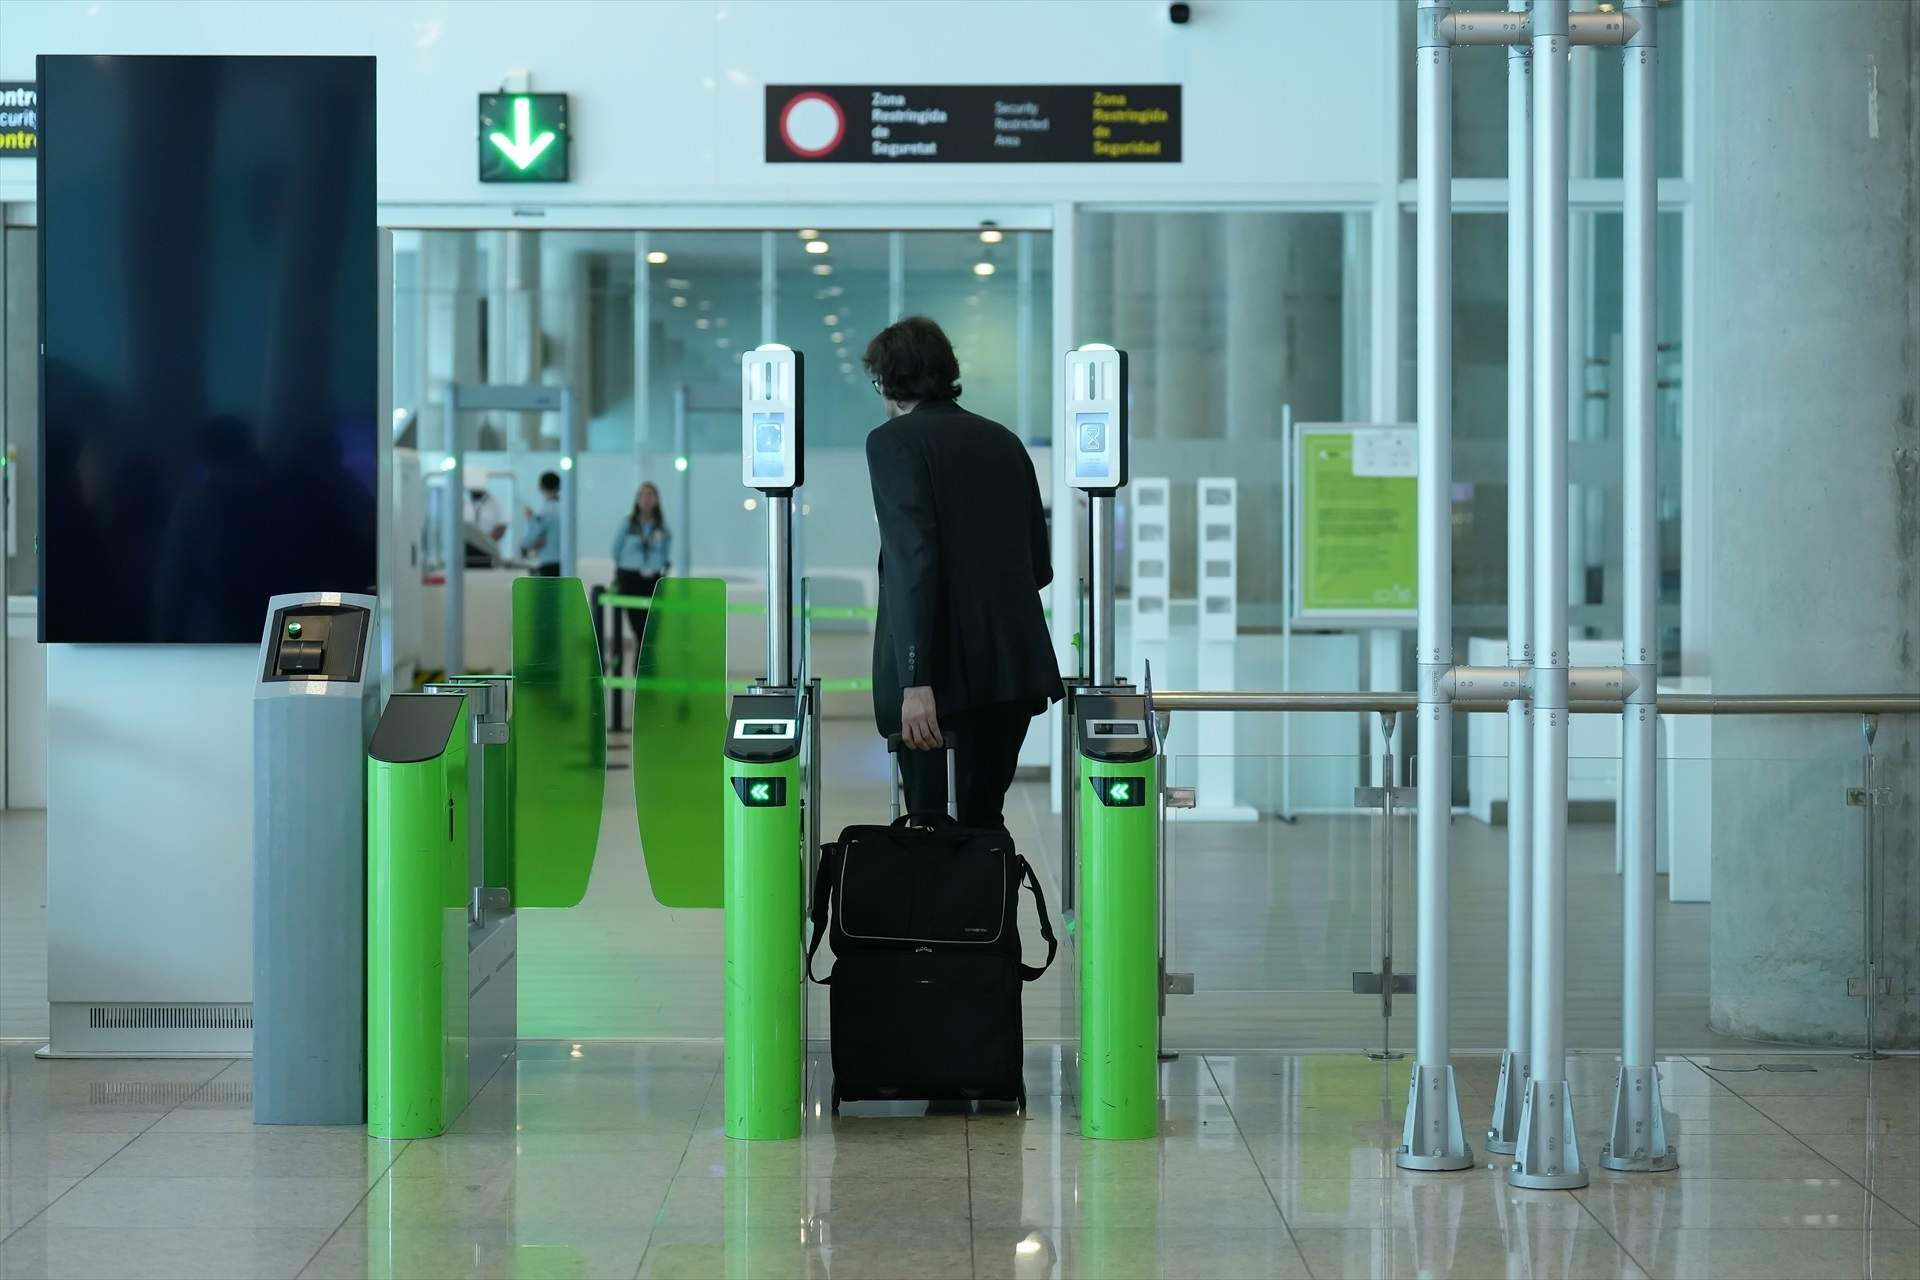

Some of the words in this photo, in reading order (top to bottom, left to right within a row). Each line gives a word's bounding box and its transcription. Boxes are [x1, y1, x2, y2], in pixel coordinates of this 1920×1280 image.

[872, 108, 948, 124] Restringida
[1093, 108, 1168, 124] Restringida
[872, 125, 890, 139] de
[1093, 125, 1110, 139] de
[1093, 141, 1161, 157] Seguridad
